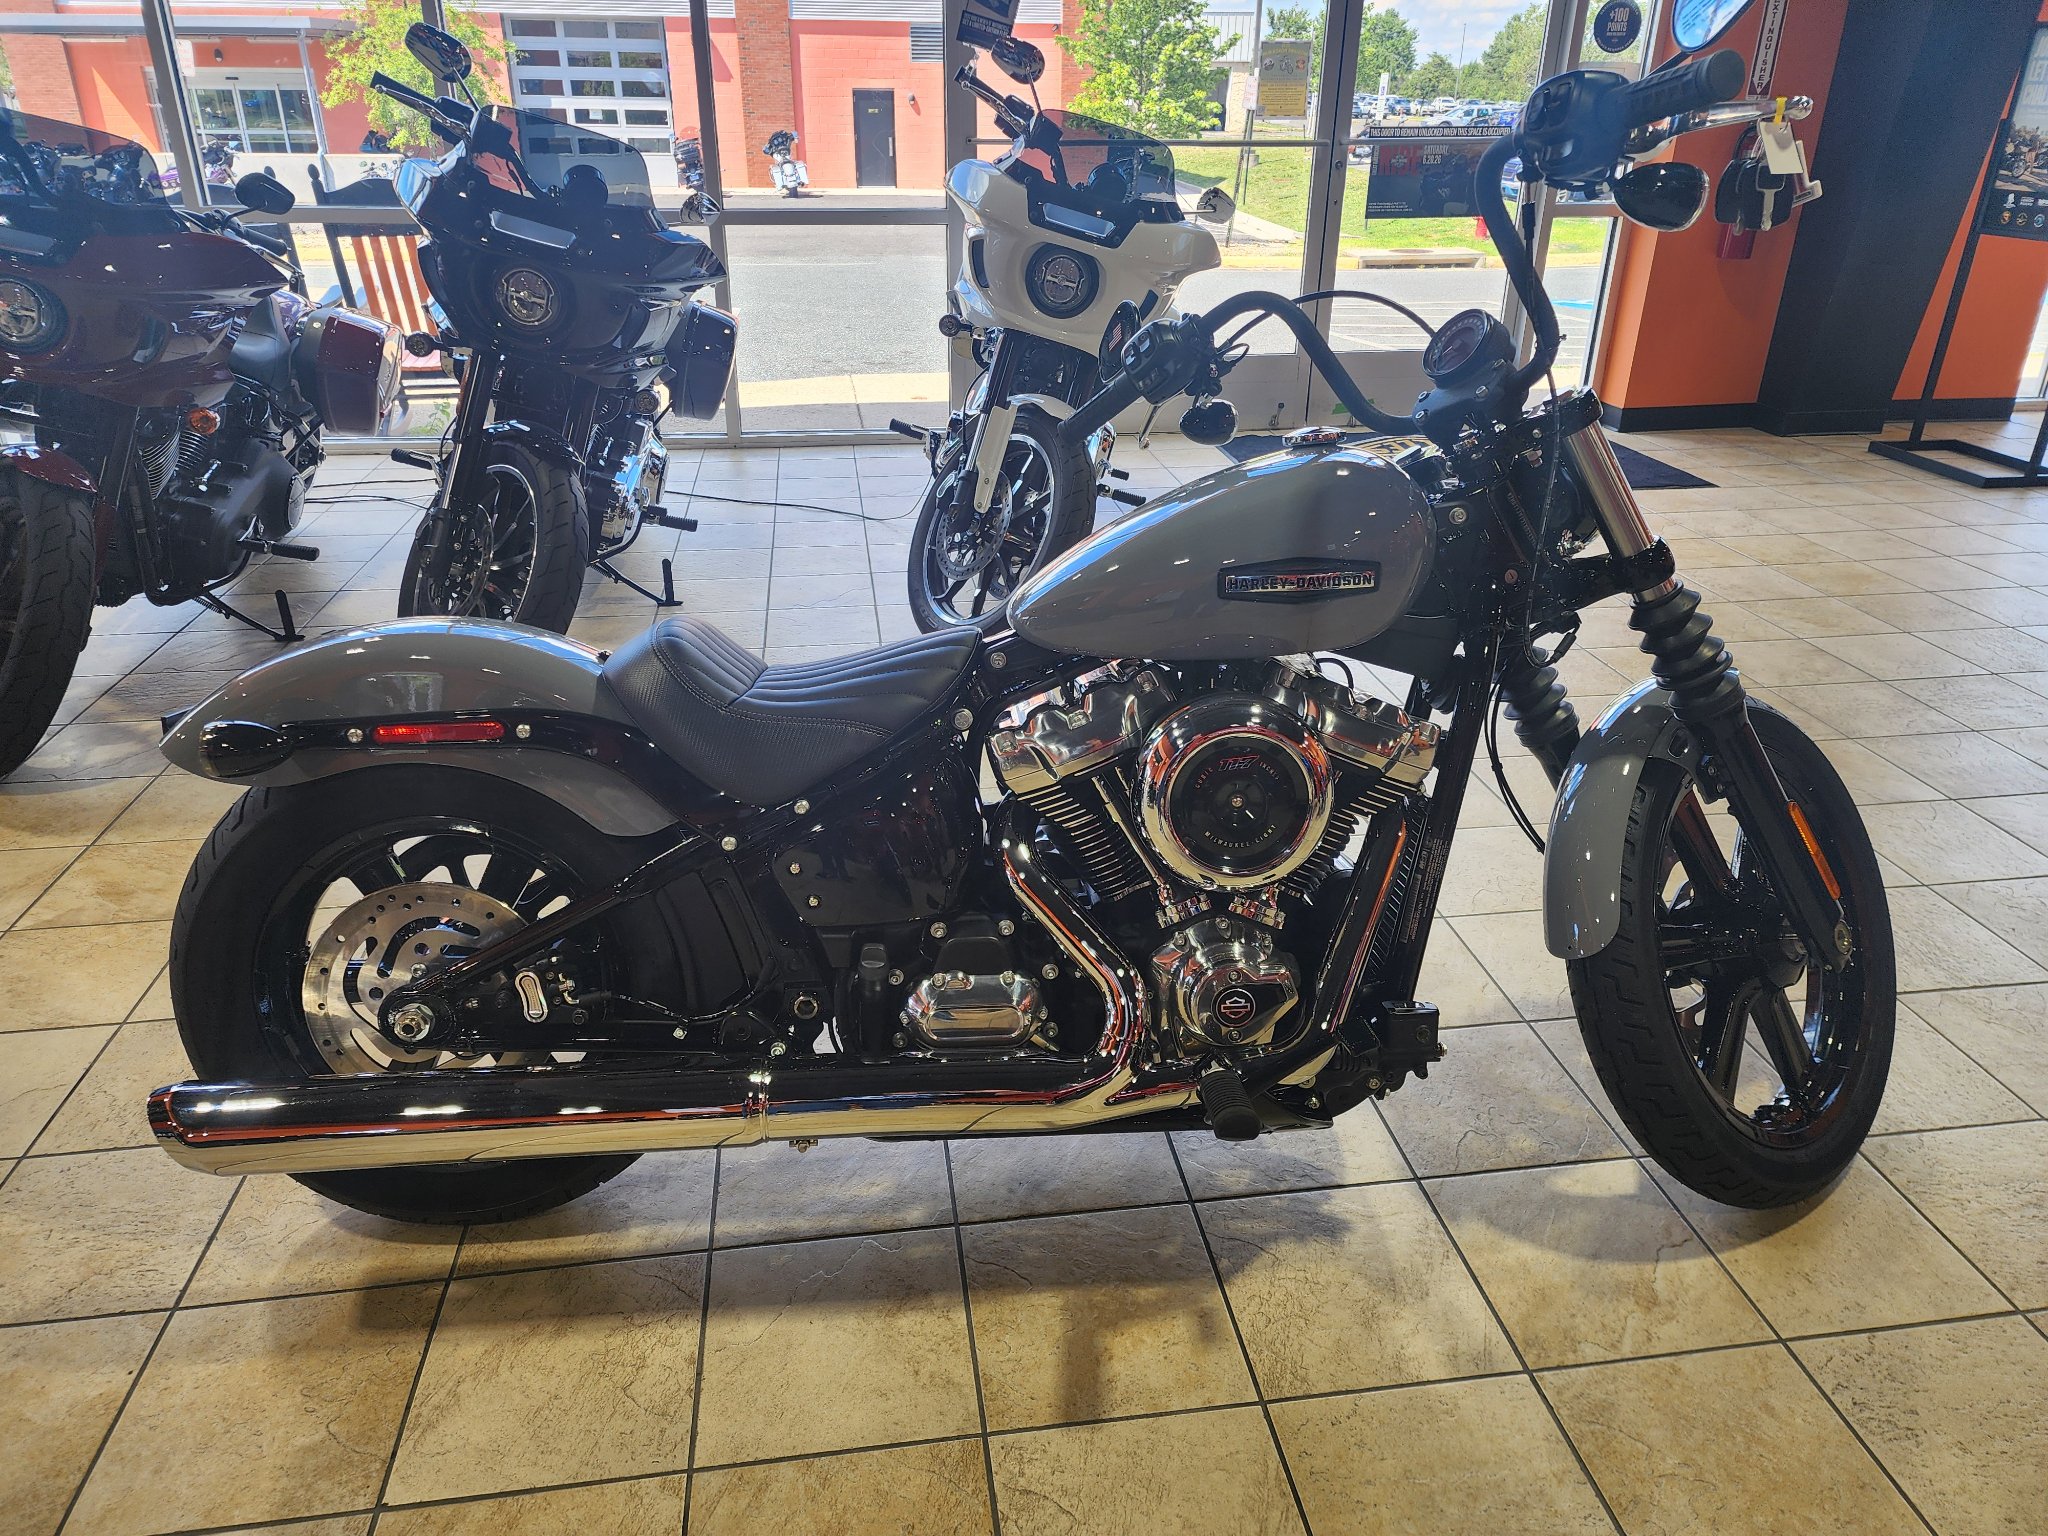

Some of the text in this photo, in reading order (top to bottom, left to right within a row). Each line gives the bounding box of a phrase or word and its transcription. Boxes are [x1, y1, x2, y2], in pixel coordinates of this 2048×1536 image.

[1610, 7, 1630, 22] +100
[1607, 22, 1628, 31] POINTS
[1370, 127, 1511, 137] THIS DOOR TO REMAIN UNLOCKED WHEN THIS SPACE IS OCCUPIED
[1423, 145, 1449, 155] SATURDAY
[1227, 571, 1375, 591] HARLEY-DAVIDSON
[1195, 767, 1214, 789] CUBIC
